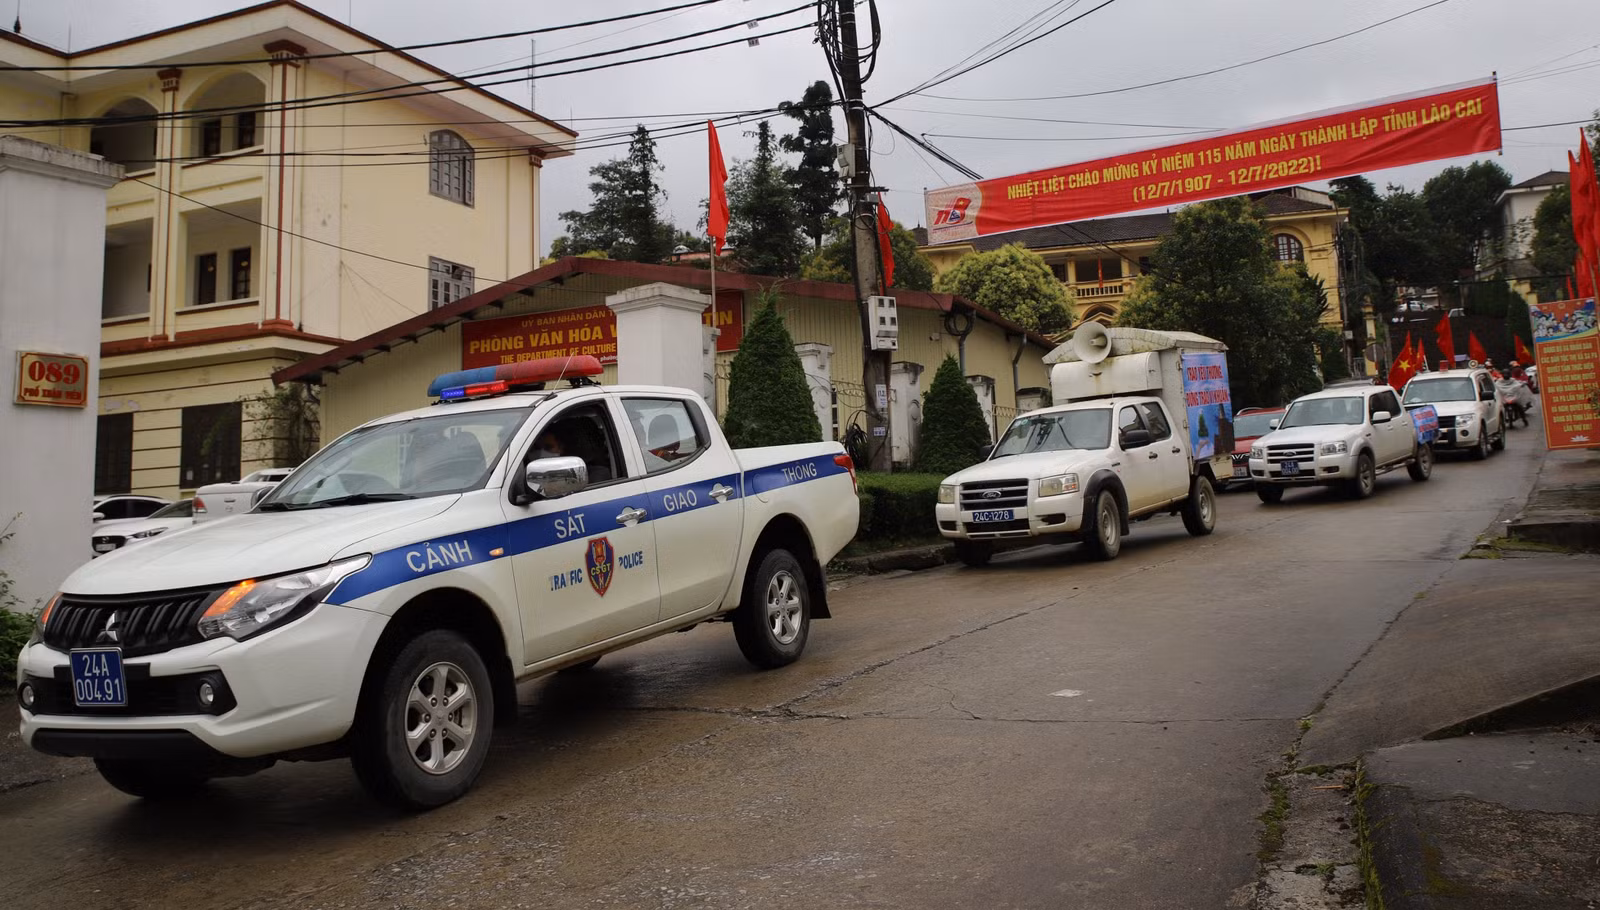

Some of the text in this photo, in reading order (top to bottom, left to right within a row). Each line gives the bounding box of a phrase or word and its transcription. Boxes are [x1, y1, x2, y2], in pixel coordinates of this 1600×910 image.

[1007, 98, 1482, 200] NHIỆT LIỆT CHÀO MỪNG KỶ NIỆM 115 NĂM NGÀY THÀNH LẬP TỈNH LÀO CAI
[1133, 174, 1212, 202] (12/7/1907
[1228, 155, 1321, 185] 12/7/2022)!
[537, 316, 556, 326] BAN
[558, 312, 583, 323] NHÂN
[585, 309, 606, 320] DÂN
[469, 334, 524, 354] PHÒNG
[529, 328, 563, 348] VĂN
[568, 323, 604, 343] HÓA
[610, 324, 617, 338] V
[501, 354, 515, 365] THE
[516, 348, 567, 363] DEPARTMENT
[582, 343, 617, 355] CULTURE
[28, 361, 80, 385] 089
[974, 510, 1010, 522] 24C-1278
[406, 540, 473, 573] CẢNH
[554, 510, 586, 539] SÁT
[663, 489, 698, 512] GIAO
[82, 654, 110, 676] 24A
[76, 678, 121, 701] 004.91
